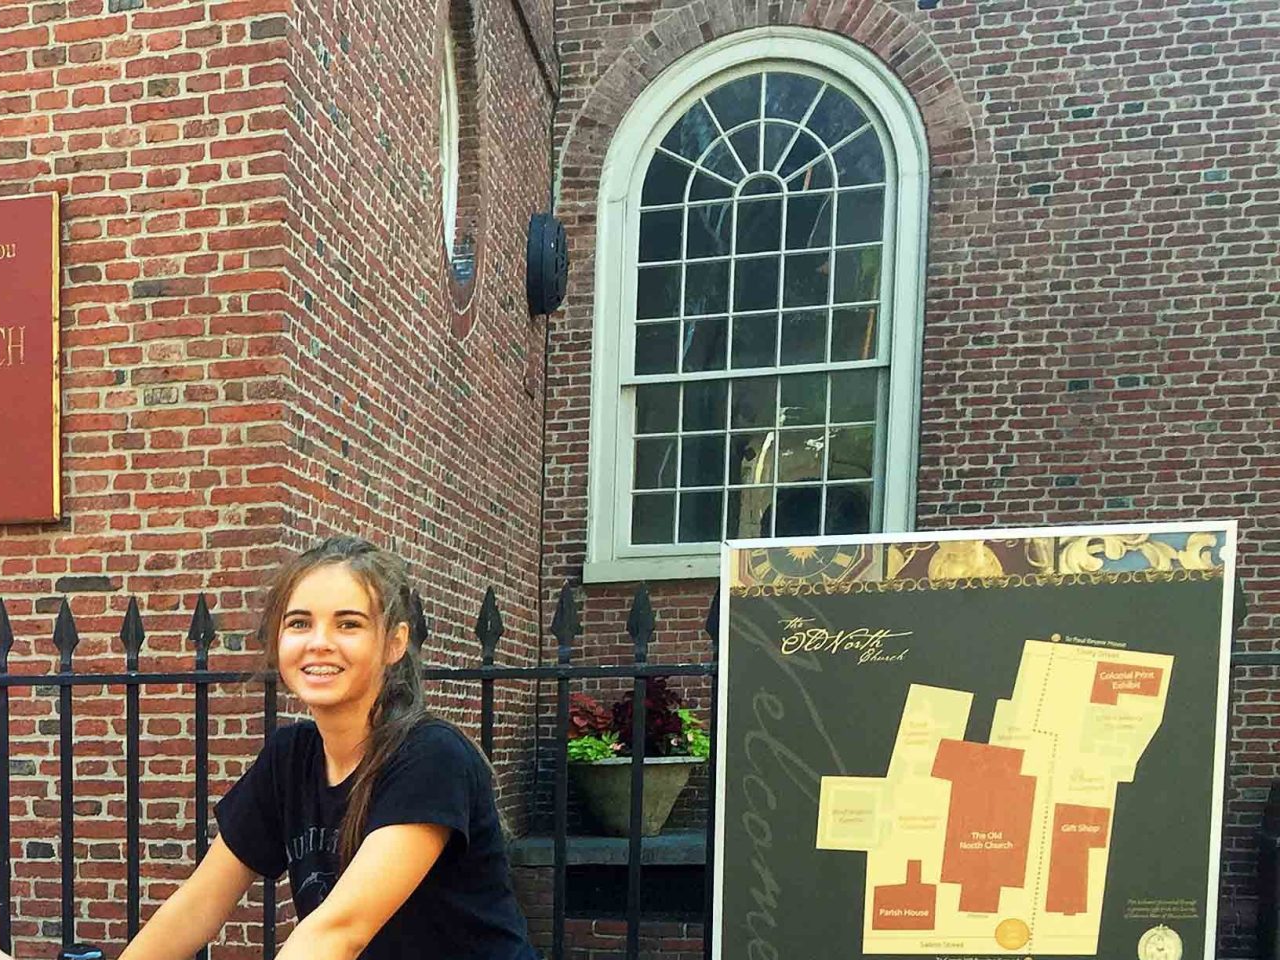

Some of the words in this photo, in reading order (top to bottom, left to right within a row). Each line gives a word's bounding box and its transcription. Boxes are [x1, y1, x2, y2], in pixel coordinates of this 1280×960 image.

[824, 627, 913, 655] North
[857, 648, 910, 665] Church
[1099, 671, 1133, 680] Colonial
[1135, 671, 1155, 680] Print
[1077, 823, 1100, 833] Shop
[971, 831, 986, 840] The
[987, 831, 1003, 840] Old
[959, 841, 983, 850] North
[984, 841, 1014, 850] Church
[879, 908, 902, 917] Parish
[904, 909, 930, 917] House
